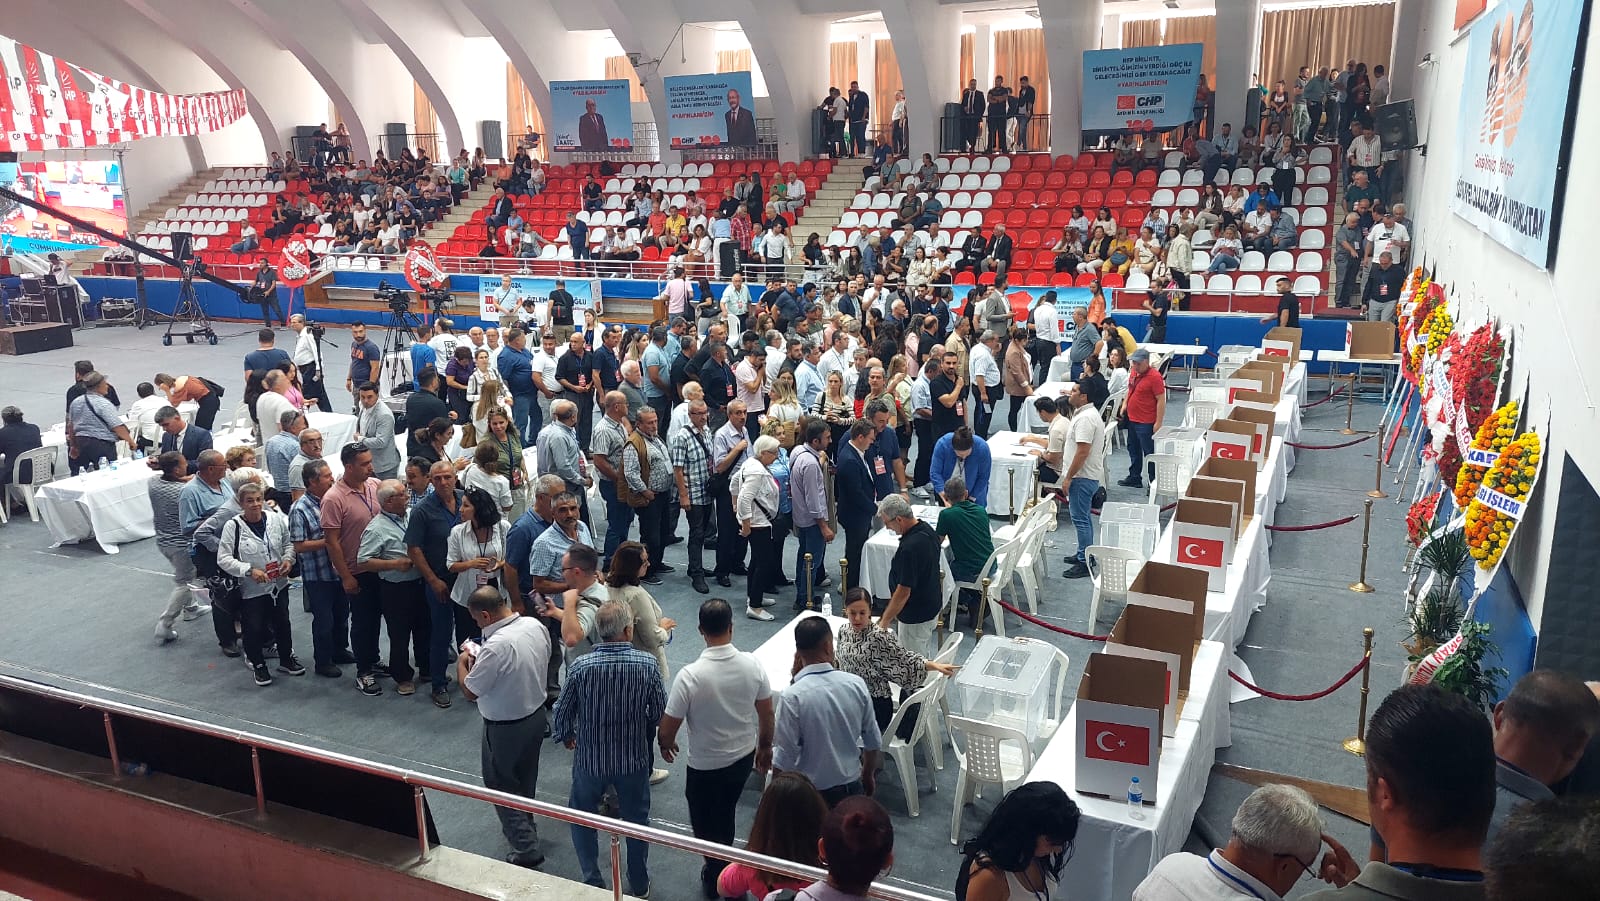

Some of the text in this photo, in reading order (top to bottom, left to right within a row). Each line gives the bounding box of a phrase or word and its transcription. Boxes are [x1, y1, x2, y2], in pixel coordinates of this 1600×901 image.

[1137, 95, 1163, 107] CHP
[681, 136, 695, 144] CHP
[1487, 491, 1520, 515] İŞLEM
